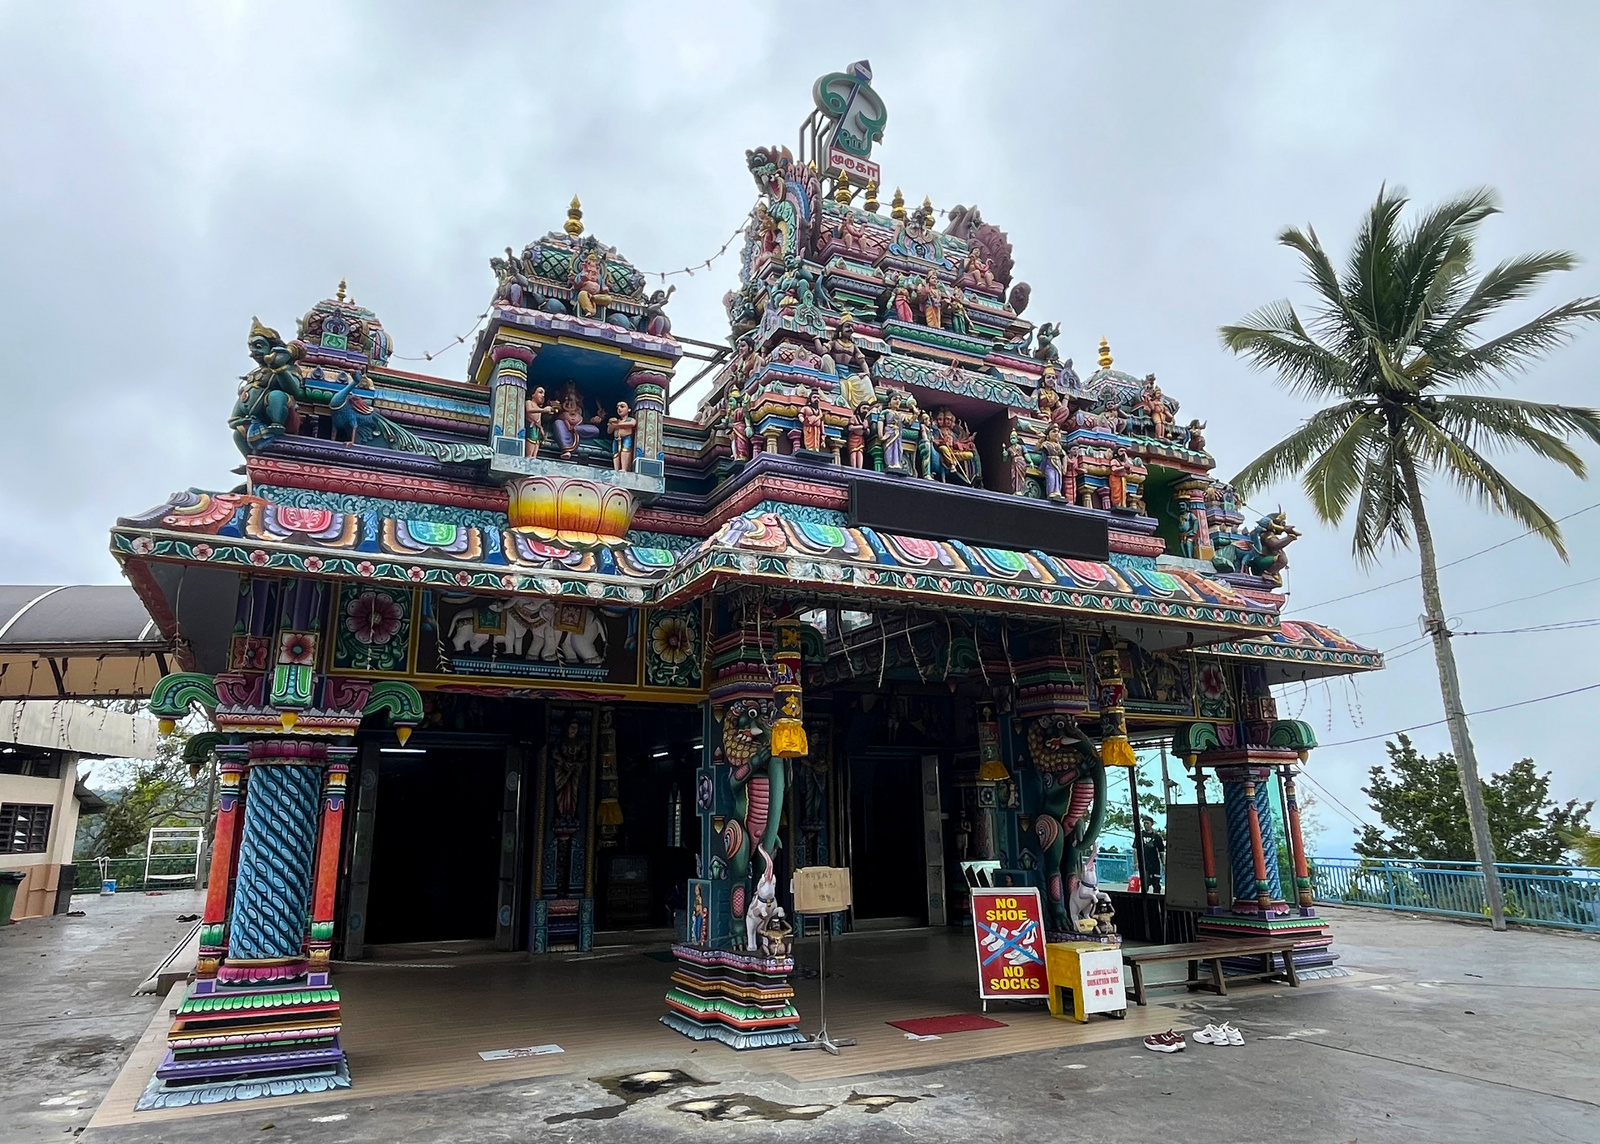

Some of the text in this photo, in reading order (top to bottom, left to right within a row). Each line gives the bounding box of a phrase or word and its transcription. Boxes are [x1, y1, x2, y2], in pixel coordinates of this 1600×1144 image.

[831, 154, 879, 178] முருகா
[995, 898, 1017, 909] NO
[986, 910, 1028, 921] SHOE
[1003, 966, 1024, 977] NO
[990, 978, 1040, 990] SOCKS
[1087, 976, 1119, 986] DONATION BOX
